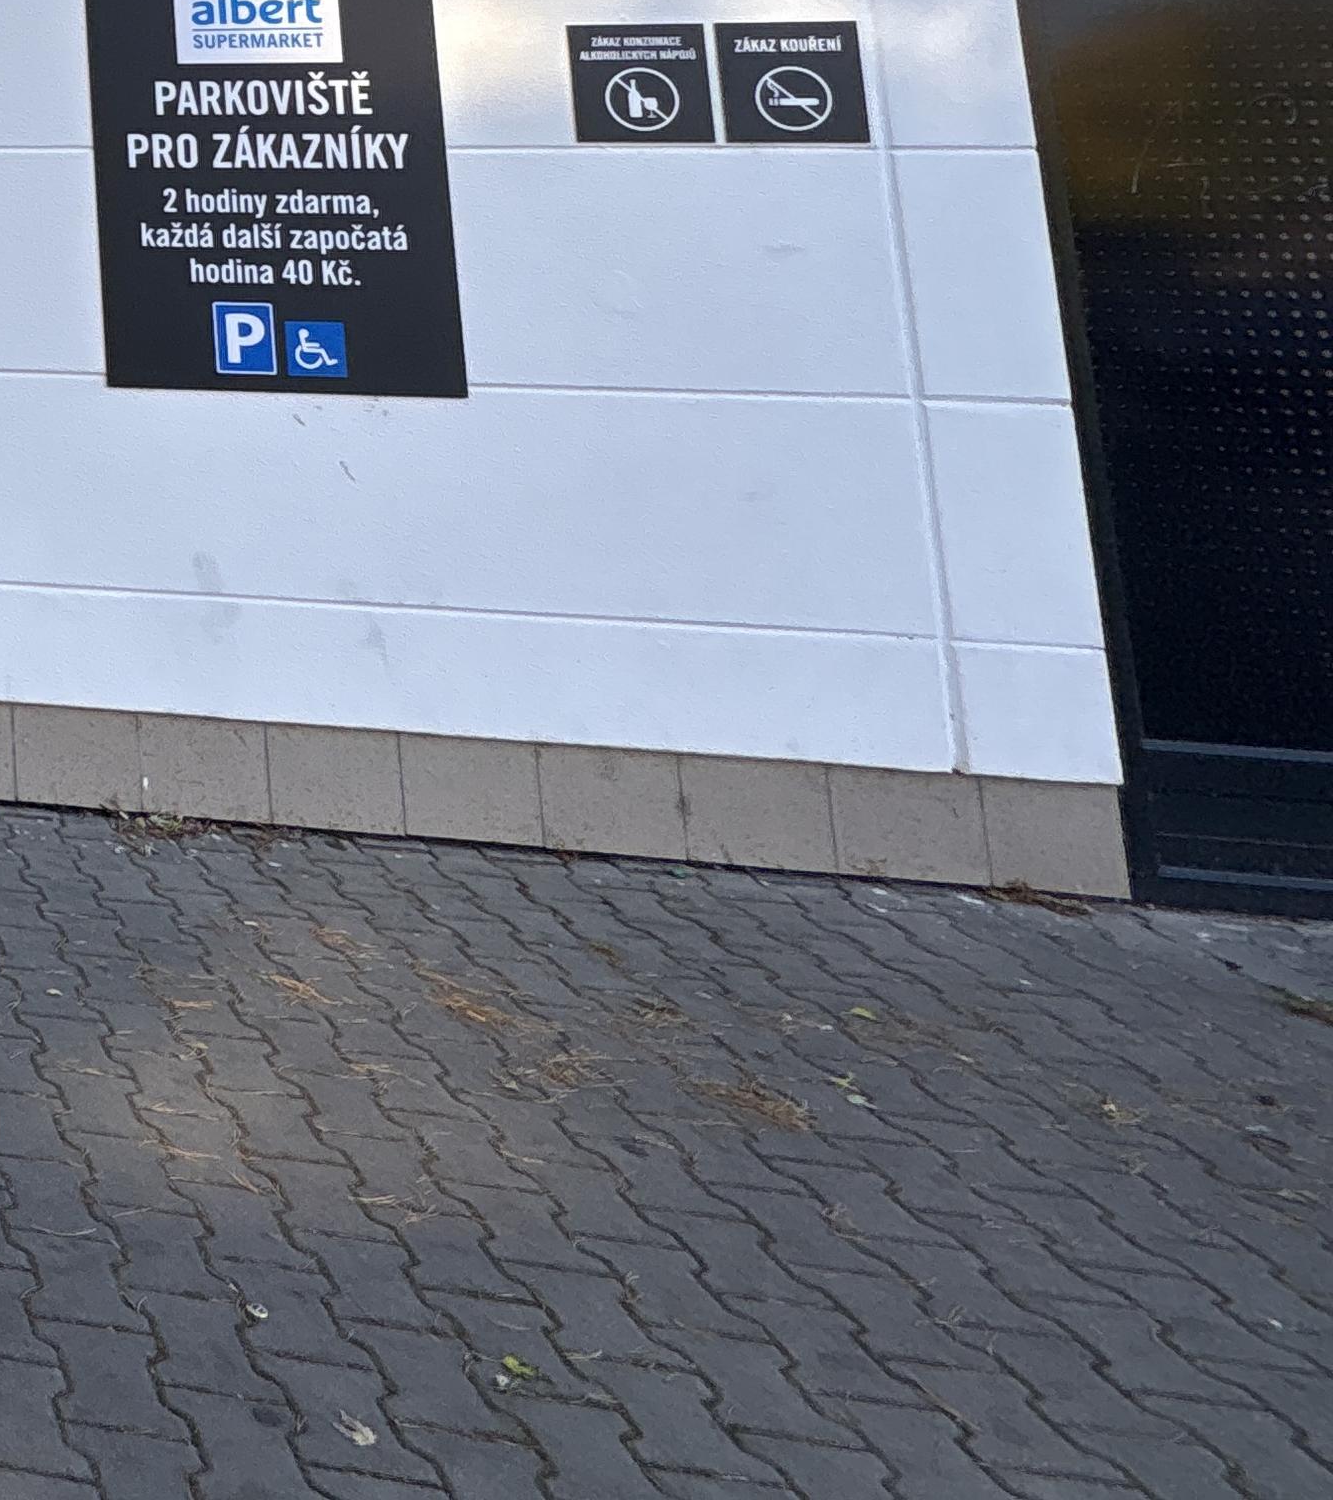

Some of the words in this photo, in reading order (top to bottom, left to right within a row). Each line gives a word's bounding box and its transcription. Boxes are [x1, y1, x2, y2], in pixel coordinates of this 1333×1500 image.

[192, 32, 324, 49] SUPERMARKET
[590, 35, 622, 47] ZÁKAZ
[733, 36, 778, 52] ZÁKAZ
[779, 34, 843, 52] KOUŘENÍ
[154, 71, 374, 116] PARKOVIŠTĚ
[126, 132, 199, 169] PRO
[212, 125, 410, 169] ZÁKAZNÍKY
[162, 187, 178, 213] 2
[185, 188, 268, 218] hodiny
[275, 189, 380, 219] zdarma,
[140, 222, 214, 248] každá
[222, 223, 282, 249] další
[289, 224, 409, 255] započatá
[189, 258, 275, 285] hodina
[282, 259, 313, 286] 40
[321, 259, 362, 286] Kč.
